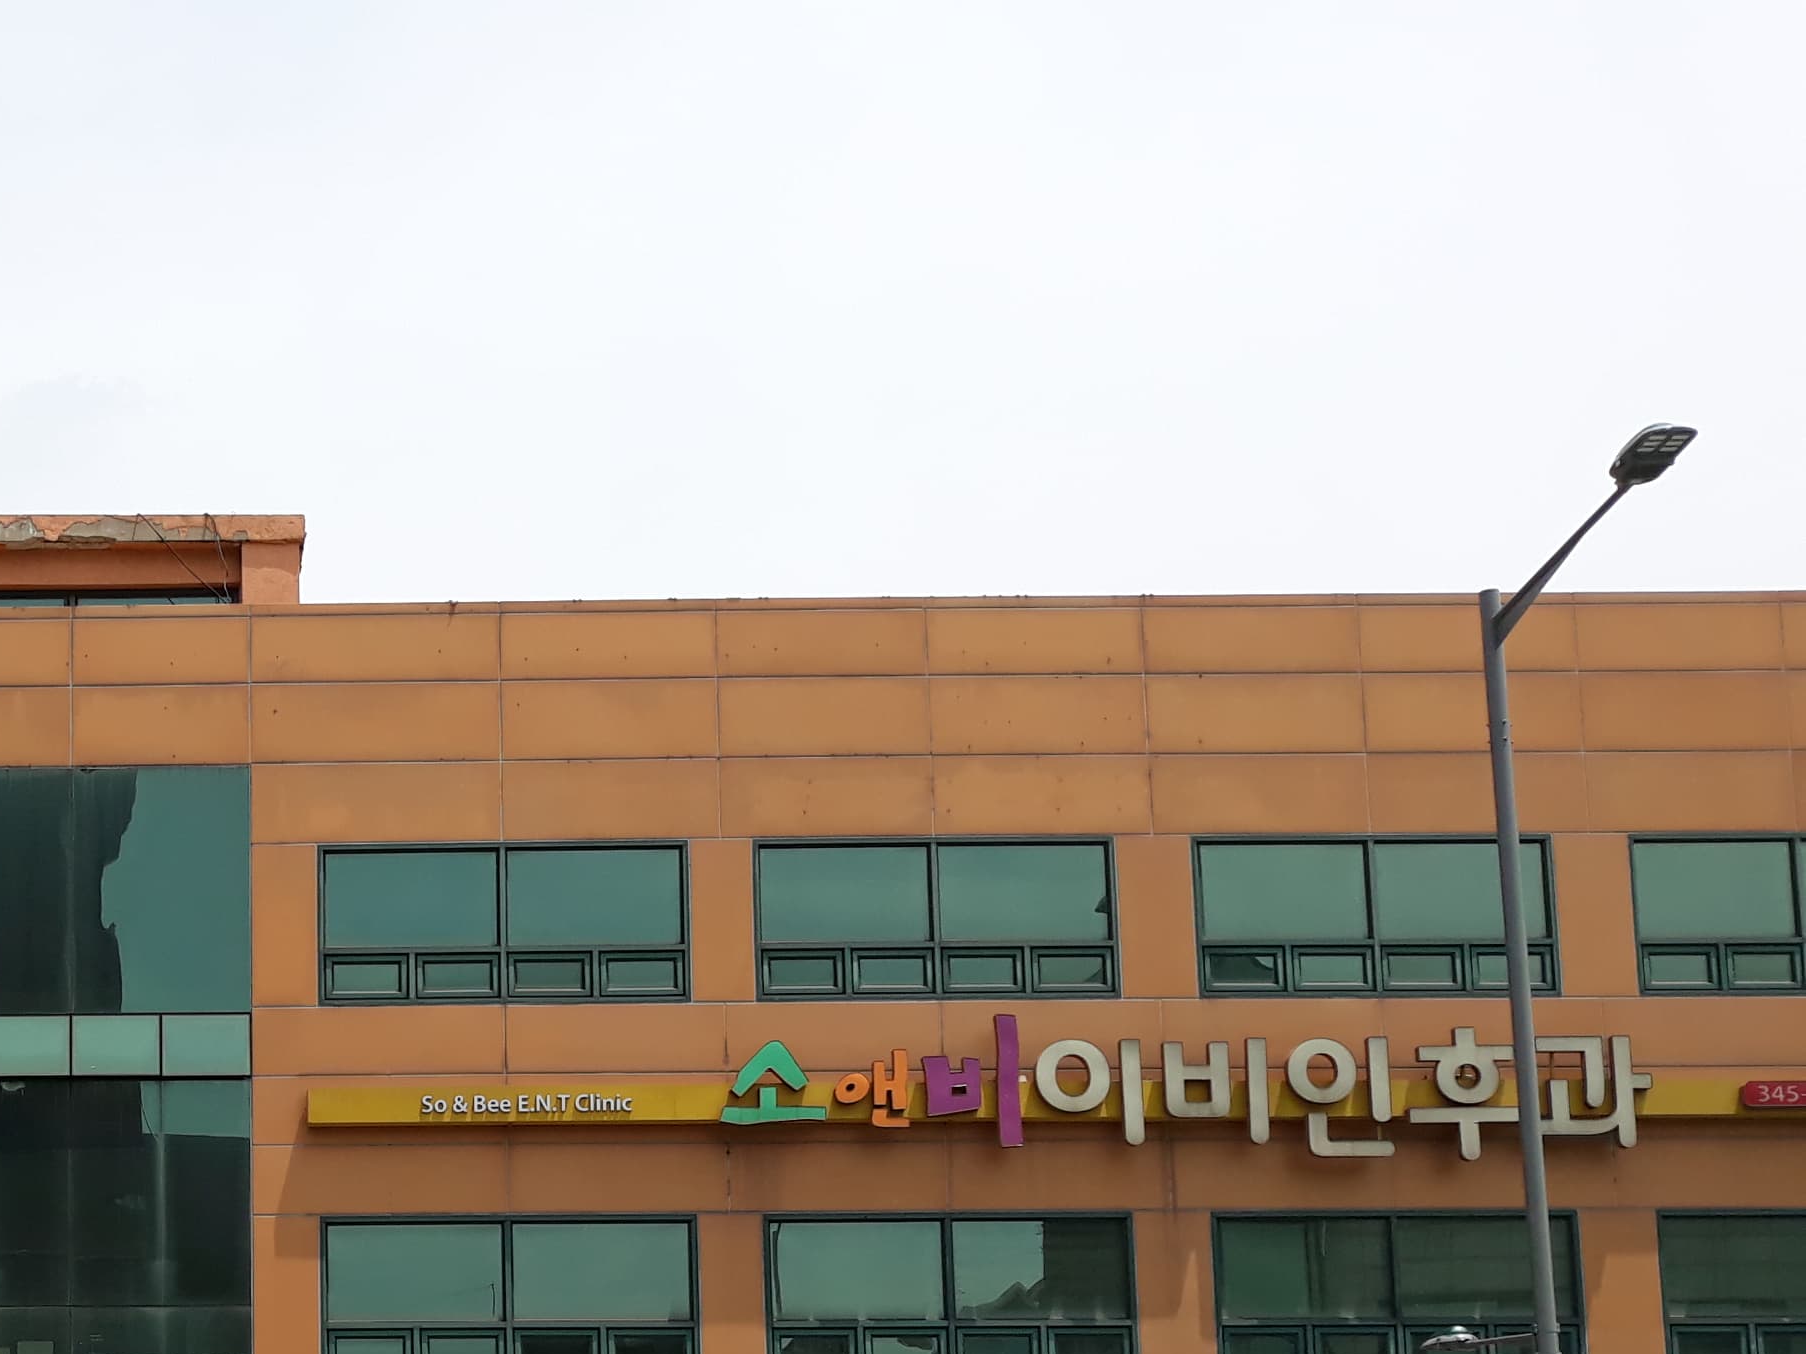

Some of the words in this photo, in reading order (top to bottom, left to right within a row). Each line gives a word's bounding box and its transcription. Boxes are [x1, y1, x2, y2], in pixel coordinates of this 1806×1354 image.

[421, 1095, 448, 1112] So
[452, 1095, 468, 1112] &
[473, 1094, 512, 1112] Bee
[517, 1094, 568, 1112] E.N.T
[574, 1093, 632, 1112] Clinic
